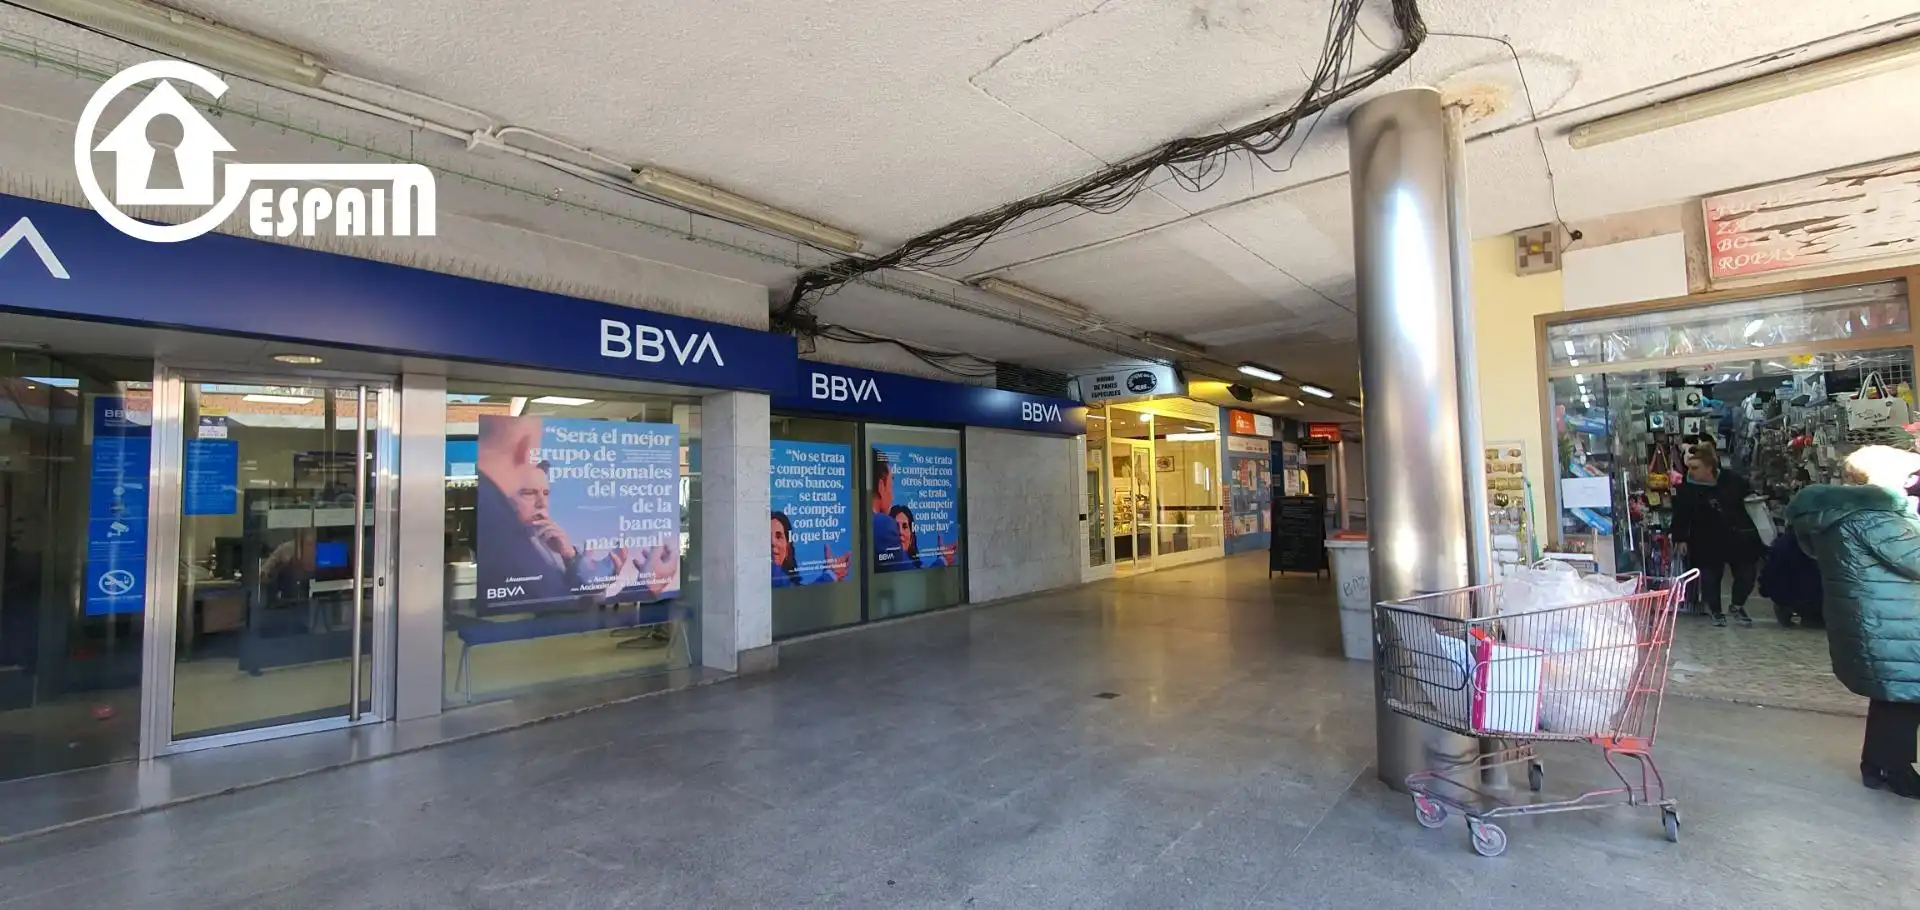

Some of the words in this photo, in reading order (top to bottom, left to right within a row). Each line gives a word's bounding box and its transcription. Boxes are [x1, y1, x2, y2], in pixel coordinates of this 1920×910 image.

[601, 319, 724, 367] BBVA
[811, 372, 882, 403] BBVA
[1022, 401, 1062, 422] BBVA
[602, 428, 617, 444] el
[622, 430, 673, 448] mejor
[529, 448, 590, 464] grupo
[594, 447, 617, 462] de
[808, 453, 820, 462] se
[821, 453, 845, 463] trata
[934, 456, 953, 465] trata
[548, 463, 673, 483] profesionales
[777, 464, 826, 477] competir
[827, 467, 845, 476] con
[891, 464, 901, 474] de
[903, 465, 938, 477] competir
[939, 468, 953, 476] con
[775, 479, 804, 488] otros
[901, 478, 922, 486] otros
[587, 481, 616, 497] del
[619, 484, 673, 497] sector
[928, 489, 947, 498] trata
[799, 493, 811, 502] se
[812, 492, 837, 502] trata
[632, 498, 654, 513] de
[657, 498, 673, 513] la
[784, 503, 797, 515] de
[799, 502, 846, 516] competir
[908, 499, 918, 509] de
[919, 498, 953, 511] competir
[916, 512, 930, 520] con
[931, 510, 948, 520] todo
[619, 516, 672, 531] banca
[793, 519, 813, 528] con
[815, 516, 838, 527] todo
[911, 521, 920, 532] lo
[920, 523, 936, 534] que
[788, 530, 798, 542] lo
[801, 532, 820, 544] que
[487, 585, 525, 600] BBVA
